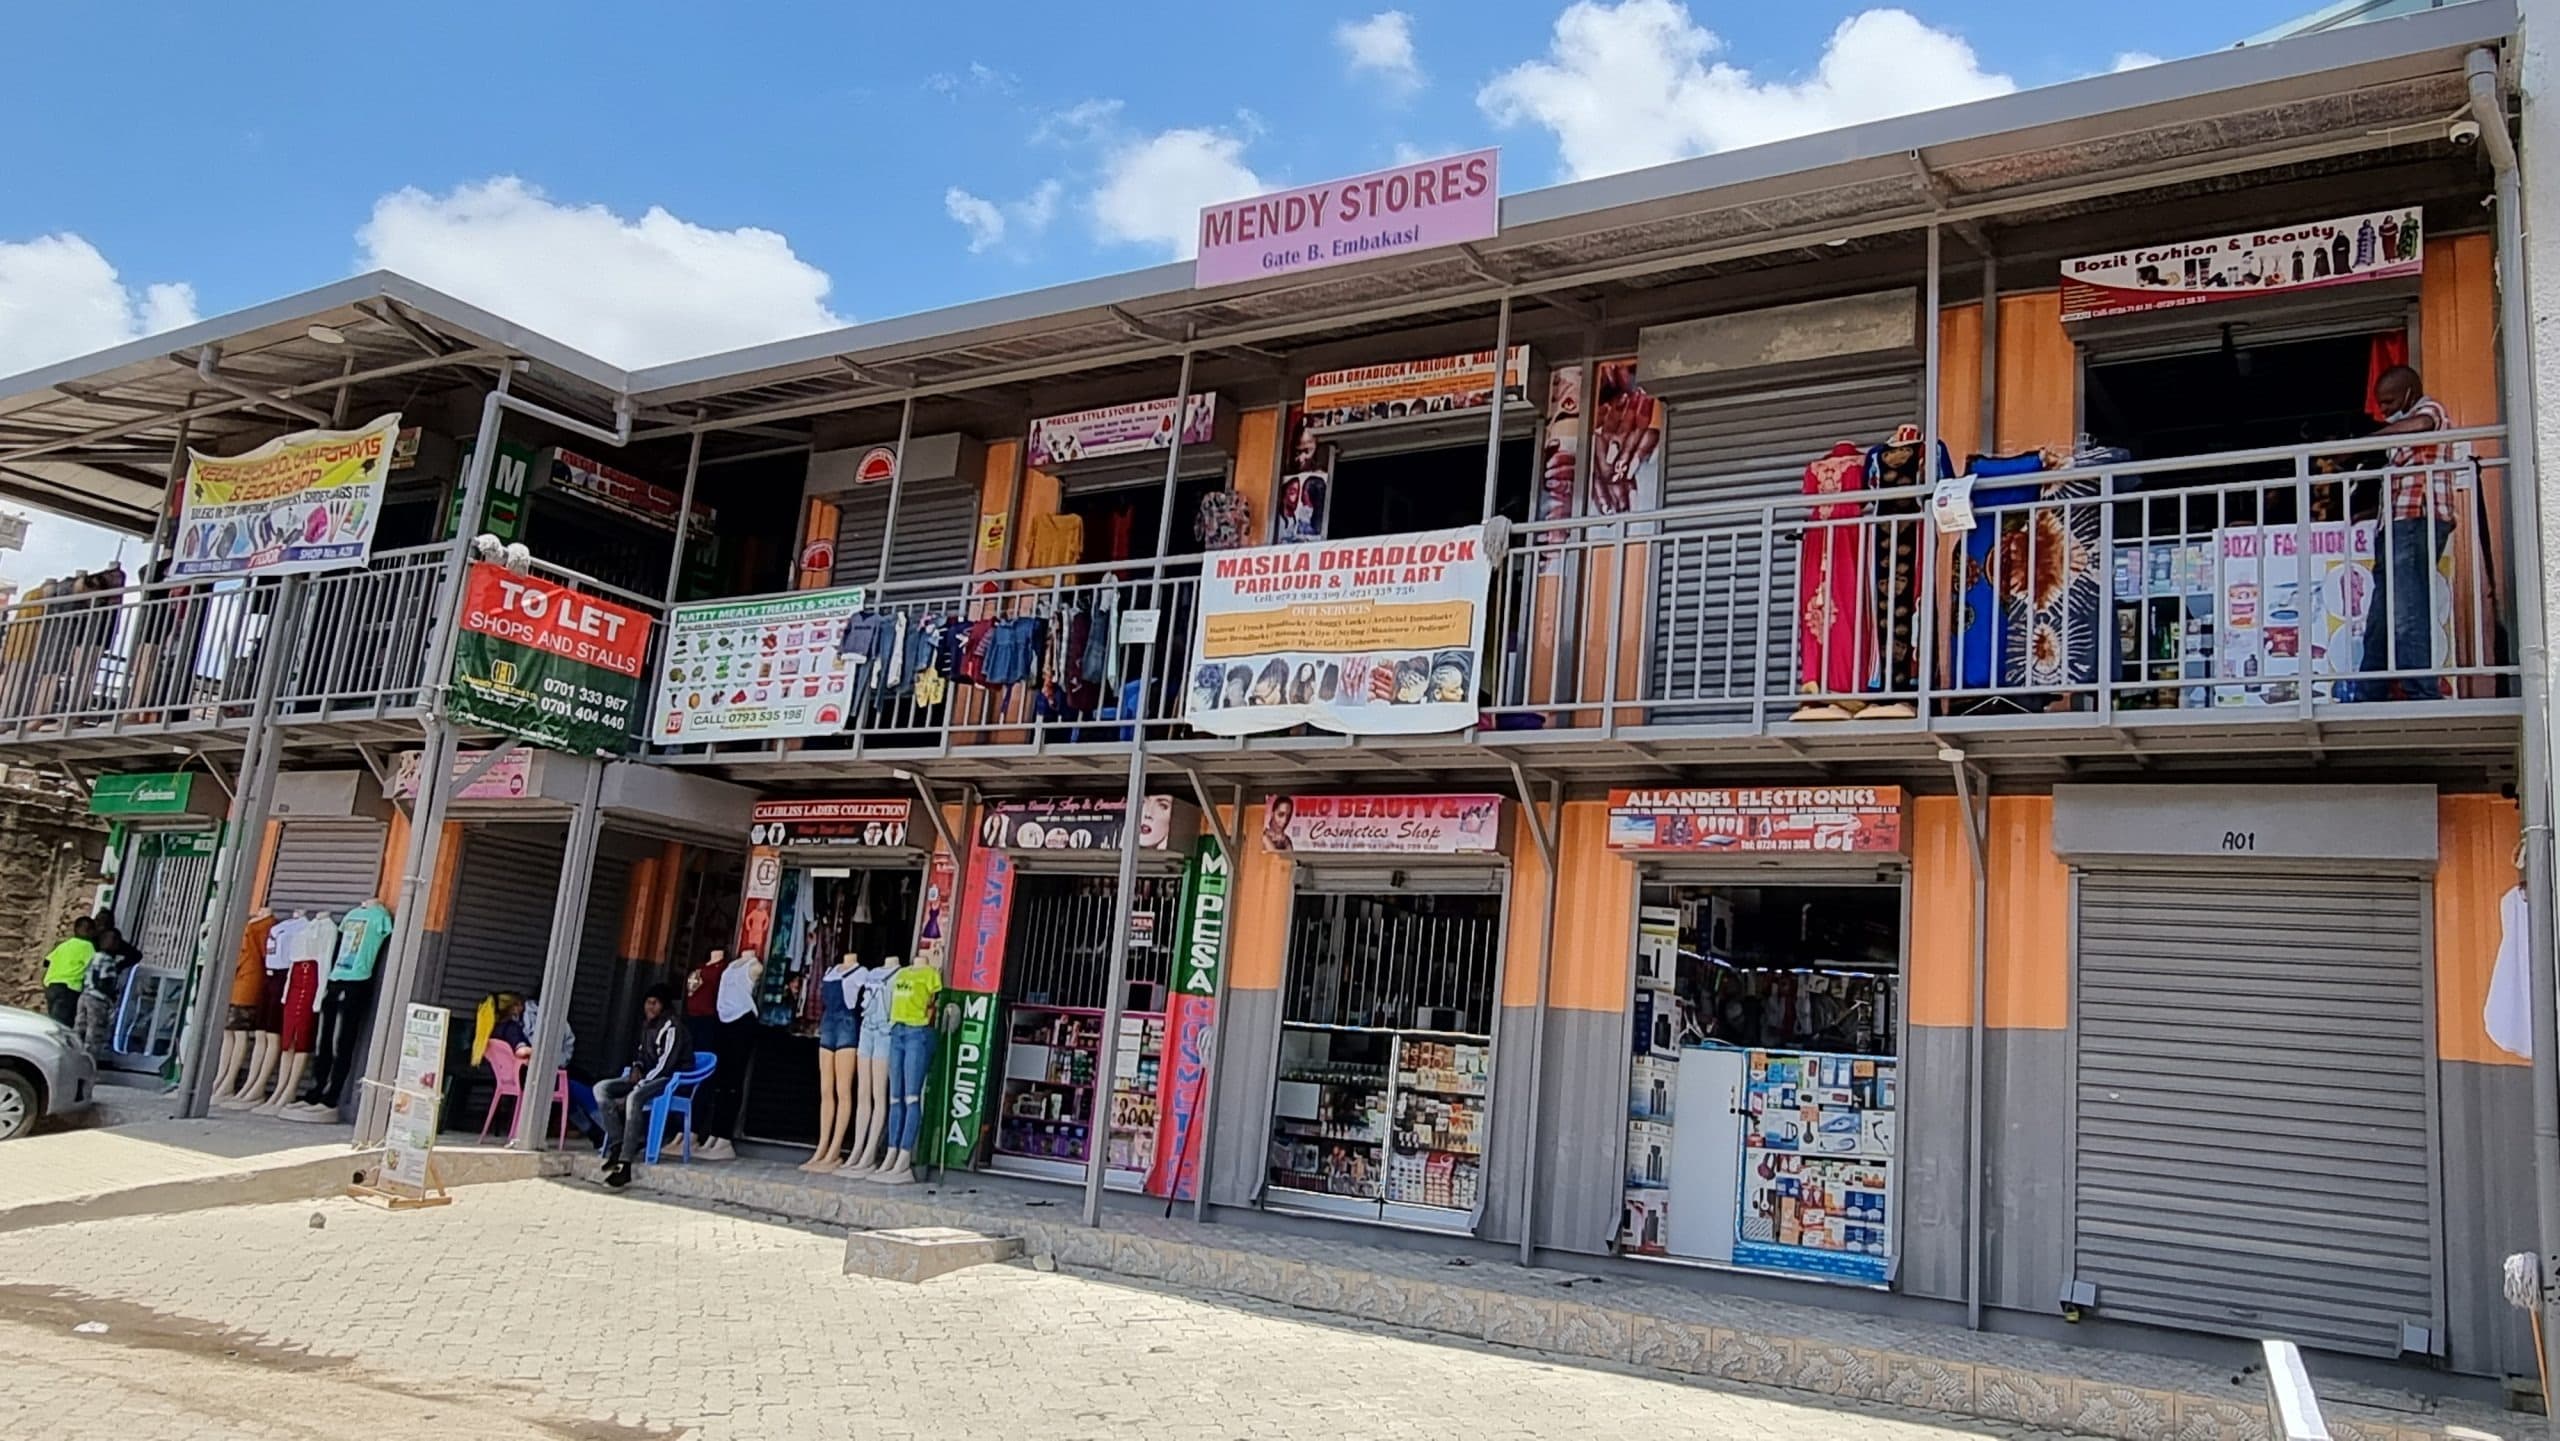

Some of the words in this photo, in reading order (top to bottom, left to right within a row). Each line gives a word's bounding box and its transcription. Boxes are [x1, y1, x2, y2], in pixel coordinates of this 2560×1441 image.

[1204, 190, 1330, 248] MENDY
[1339, 158, 1488, 222] STORES
[1262, 249, 1300, 270] Gate
[1308, 244, 1324, 261] B.
[1333, 224, 1420, 257] Embakasi
[2074, 255, 2128, 273] Bozit
[2227, 238, 2241, 252] &
[2252, 224, 2335, 248] Beauty
[1306, 372, 1345, 388] MASILA
[1346, 361, 1406, 383] DREADLOCK
[1409, 355, 1456, 374] PARLOUR
[1472, 350, 1496, 365] NAIL
[1046, 415, 1080, 427] PRECISE
[1081, 411, 1107, 422] STYLE
[1108, 405, 1137, 419] STORE
[2355, 530, 2368, 554] &
[1216, 551, 1311, 578] MASILA
[1319, 540, 1477, 571] DREADLOCK
[1234, 573, 1322, 595] PARLOUR
[1328, 575, 1342, 588] &
[1353, 569, 1400, 587] NAIL
[1402, 566, 1445, 583] ART
[500, 580, 548, 618] TO
[558, 599, 626, 642] LET
[678, 611, 717, 623] NATTY
[719, 607, 759, 620] MEATY
[760, 602, 804, 615] TREATS
[806, 600, 816, 610] &
[817, 594, 861, 608] SPICES
[1292, 605, 1318, 617] OUR
[470, 611, 534, 641] SHOPS
[537, 631, 573, 654] AND
[576, 642, 636, 673] STALLS
[544, 678, 575, 698] 0701
[579, 687, 602, 705] 333
[541, 697, 572, 715] 0701
[575, 705, 599, 723] 404
[601, 714, 625, 730] 440
[693, 712, 725, 726] CALL:
[728, 711, 756, 724] 0793
[803, 805, 840, 816] LADIES
[841, 804, 906, 816] COLLECTION
[1338, 797, 1438, 819] BEAUTY
[1440, 798, 1459, 819] &
[1625, 790, 1731, 807] ALLANDES
[1738, 789, 1876, 806] ELECTRONICS
[1309, 820, 1389, 840] Cosmetics
[1397, 820, 1441, 843] Shop
[2222, 831, 2254, 851] A01
